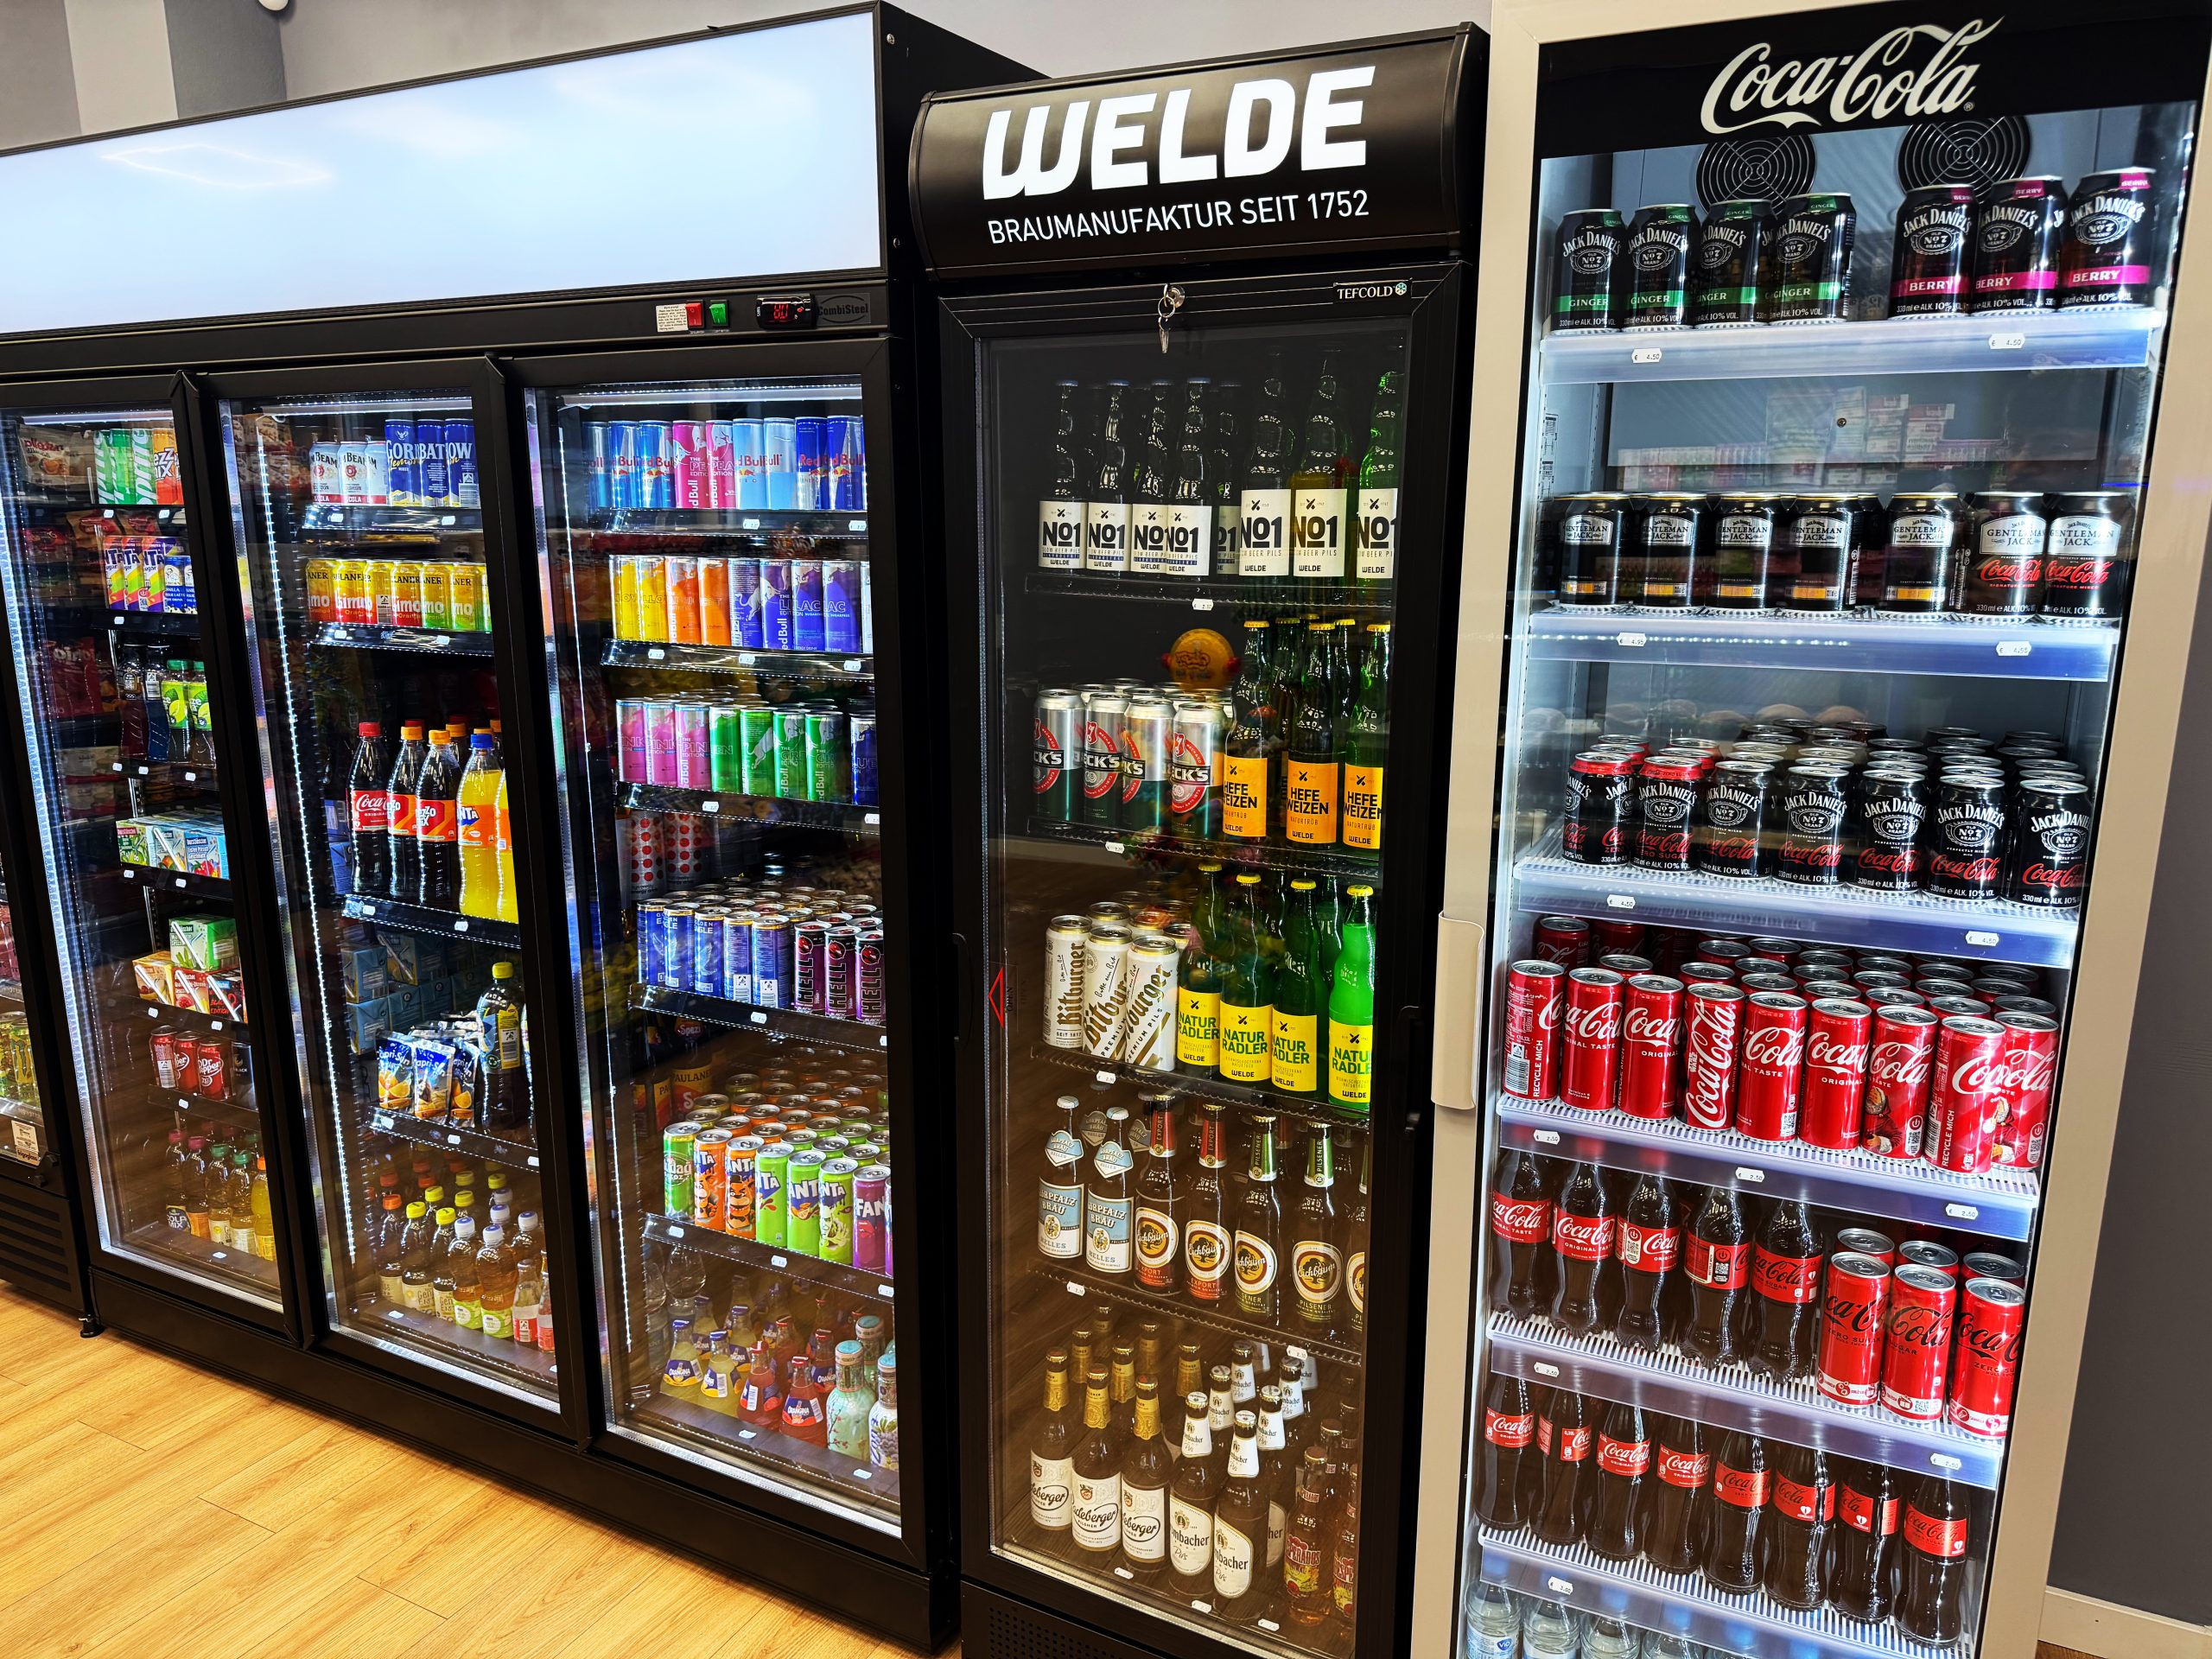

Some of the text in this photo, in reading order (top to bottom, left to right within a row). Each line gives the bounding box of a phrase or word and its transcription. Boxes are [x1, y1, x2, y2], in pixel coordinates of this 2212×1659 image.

[1700, 16, 2005, 134] Coca-Cola
[982, 66, 1376, 200] WELDE
[2015, 187, 2044, 197] BERRY
[988, 190, 1370, 245] BRAUMANUFAKTUR SEIT 1752
[1992, 205, 2039, 233] DANIEL'S
[1788, 218, 1831, 244] DANIEL'S
[1903, 215, 1929, 241] JACK
[1709, 225, 1746, 249] DANIEL'S
[1562, 238, 1585, 259] JACK
[1628, 233, 1646, 256] JACK
[1975, 276, 2014, 289] BERRY
[2072, 269, 2120, 283] BERRY
[1910, 279, 1953, 291] BERRY
[1338, 285, 1395, 300] TEFCOLD
[1630, 294, 1671, 305] GINGER
[1774, 288, 1811, 299] GINGER
[1569, 296, 1609, 308] GINGER
[1993, 299, 2012, 308] 10%
[817, 303, 868, 317] CombiSteel
[1710, 312, 1726, 321] 10%
[1791, 308, 1809, 317] 10%
[1652, 315, 1669, 323] 10%
[689, 480, 698, 501] Bull
[1573, 531, 1592, 541] JACK
[1652, 532, 1671, 542] JACK
[1729, 532, 1750, 542] JACK
[1803, 533, 1825, 543] JACK
[1915, 532, 1934, 542] JACK
[2006, 537, 2032, 547] JACK
[2066, 537, 2092, 548] JACK
[779, 618, 788, 638] Bull
[1224, 782, 1249, 796] HEFE
[1290, 786, 1320, 802] HEFE
[1638, 782, 1697, 808] JACK DANIEL'S
[1348, 791, 1378, 806] HEFE
[1719, 785, 1761, 815] DANIEL'S
[1784, 791, 1847, 818] JACK DANIEL'S
[1287, 799, 1329, 815] WEIZEN
[1864, 800, 1891, 820] JACK
[1937, 804, 2005, 833] JACK DANIEL'S
[2031, 812, 2062, 834] JACK
[1225, 823, 1243, 833] WELDE
[1292, 830, 1314, 840] WELDE
[1348, 836, 1371, 845] WELDE
[1657, 850, 1689, 861] SUGAR
[1778, 839, 1845, 868] Coca-Cola
[1662, 861, 1681, 870] 10%
[1723, 866, 1739, 876] 10%
[1930, 853, 2001, 882] Coca-Cola
[1798, 874, 1812, 883] ALK.
[1954, 887, 1986, 899] ALK. 10%
[798, 957, 814, 1004] HELL
[829, 961, 847, 1012] HELL
[1057, 942, 1086, 1027] Bitburger
[860, 966, 881, 1017] HELL
[1148, 1007, 1163, 1028] PILS
[1178, 1011, 1217, 1029] NATUR
[1224, 1027, 1266, 1044] NATUR
[1222, 1037, 1268, 1055] RADLER
[1183, 1052, 1205, 1063] WELDE
[1334, 1046, 1371, 1063] NATU
[1533, 1039, 1543, 1097] RECYCLE MICH
[1685, 998, 1737, 1128] Coca-Cola
[1230, 1069, 1255, 1078] WELDE
[1753, 1069, 1783, 1078] TASTE
[1274, 1075, 1295, 1088] WELDE
[1342, 1090, 1367, 1099] WELDE
[1942, 1109, 1955, 1167] RECYCLE MICH
[1041, 1199, 1065, 1217] BRÄU
[1090, 1213, 1116, 1229] BRÄU
[1511, 1228, 1533, 1236] TASTE
[1188, 1243, 1224, 1257] Eichbaum
[1564, 1242, 1597, 1252] ORIGINAL
[1297, 1263, 1336, 1279] Eichbaum
[1191, 1277, 1217, 1289] EXPORT
[1300, 1300, 1332, 1311] PILSENER
